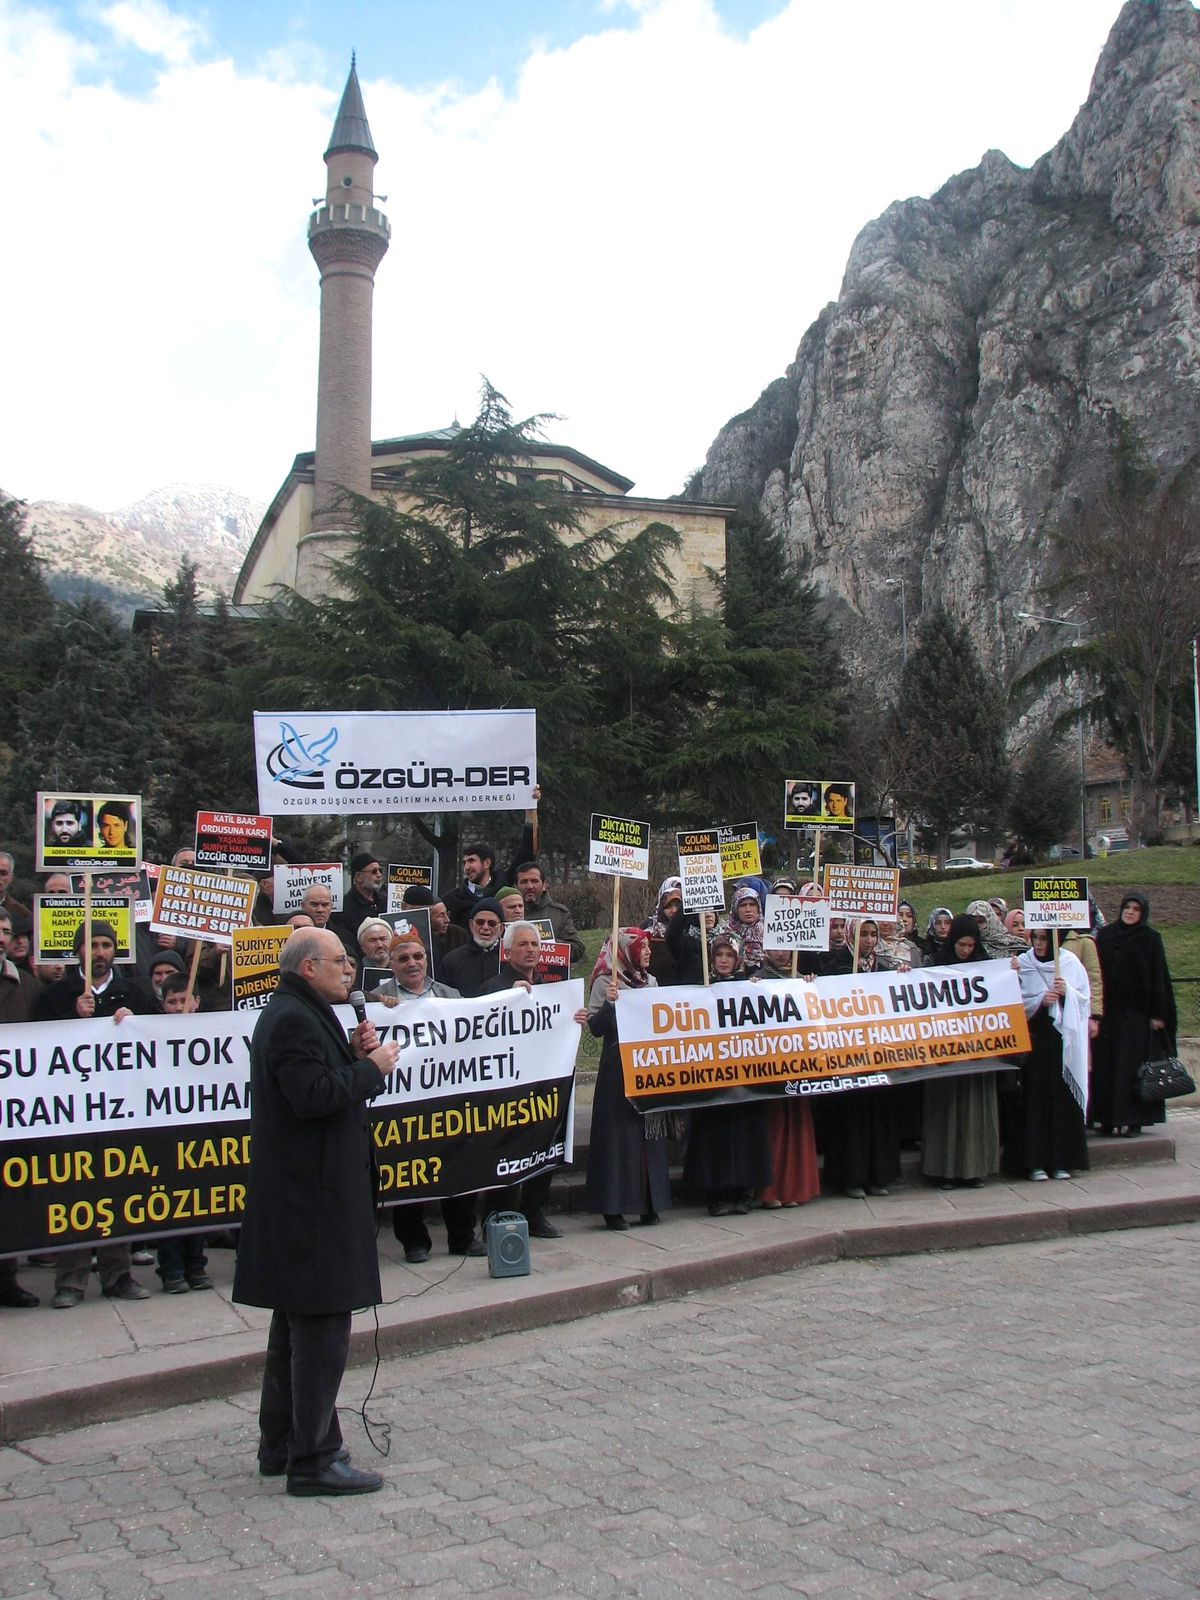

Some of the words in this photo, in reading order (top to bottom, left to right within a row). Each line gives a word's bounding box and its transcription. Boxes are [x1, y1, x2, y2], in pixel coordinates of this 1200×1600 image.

[335, 761, 530, 790] ÖZGÜR-DER
[283, 796, 318, 805] ÖZGÜR
[321, 796, 369, 806] DÜŞÜNCE
[386, 795, 421, 804] EĞİTİM
[425, 795, 469, 804] HAKLARI
[471, 793, 516, 803] DERNEĞİ
[213, 814, 235, 824] KATİL
[237, 817, 257, 826] BAAS
[601, 817, 641, 835] DİKTATÖR
[201, 825, 244, 835] ORDUSUNA
[245, 829, 268, 839] KARŞI
[625, 834, 642, 846] ESAD
[684, 834, 711, 845] GOLAN
[197, 850, 227, 861] ÖZGÜR
[228, 854, 266, 865] ORDUSU!
[604, 845, 634, 858] KATLİAM
[742, 851, 752, 859] DE
[594, 854, 620, 867] ZULÜM
[397, 867, 424, 877] GOLAN
[684, 864, 718, 876] TANKLARI
[829, 866, 850, 877] BAAS
[850, 868, 895, 880] KATLİAMINA
[165, 869, 193, 884] BAAS
[193, 876, 250, 895] KATLİAMINA
[286, 874, 333, 888] SURİYE'DE
[829, 878, 850, 888] GÖZ
[851, 880, 894, 891] YUMMA!
[1033, 878, 1078, 890] DİKTATÖR
[164, 884, 190, 898] GÖZ
[193, 889, 249, 908] YUMMA!
[685, 885, 719, 897] HAMA'DA
[829, 889, 895, 902] KATİLLERDEN
[1060, 890, 1080, 899] ESAD
[45, 898, 80, 907] TÜRKİYELİ
[81, 899, 125, 907] GZETECİLER
[683, 894, 723, 907] HUMUS'TA!
[1039, 902, 1072, 911] KATLİAM
[75, 909, 107, 918] ÖZÖSE
[161, 898, 248, 922] KATİLLERDEN
[866, 902, 894, 913] SOR!
[159, 911, 207, 928] HESAP
[774, 908, 801, 921] STOP
[803, 909, 818, 918] THE
[1029, 911, 1057, 922] ZULÜM
[51, 918, 76, 926] HAMİT
[767, 917, 825, 934] MASSACRE!
[53, 930, 74, 938] ESED
[776, 936, 785, 944] IN
[786, 929, 817, 943] SYRIA
[651, 1001, 711, 1035] Dün
[715, 992, 802, 1029] HAMA
[888, 975, 989, 1014] HUMUS
[0, 1046, 37, 1080] SU
[48, 1039, 158, 1083] AÇKEN
[166, 1035, 234, 1068] TOK
[454, 1001, 561, 1044] DEĞİLDİR"
[631, 1040, 715, 1069] KATLİAM
[718, 1028, 805, 1061] SÜRÜYOR
[808, 1024, 866, 1052] SURİYE
[867, 1022, 918, 1045] HALKI
[918, 1011, 1012, 1041] DİRENİYOR
[634, 1073, 677, 1091] BAAS
[679, 1064, 740, 1086] DİKTASI
[741, 1057, 824, 1080] YIKILACAK,
[825, 1050, 871, 1071] İSLAMİ
[874, 1045, 926, 1064] DİRENİŞ
[929, 1034, 1018, 1059] KAZANACAK!
[0, 1093, 75, 1129] RAN
[85, 1090, 135, 1122] Hz.
[419, 1045, 521, 1091] ÜMMETİ,
[801, 1073, 890, 1095] ÖZGÜR-DER
[2, 1149, 96, 1189] OLUR
[103, 1144, 160, 1179] DA,
[371, 1087, 559, 1148] KATLEDİLMESİNİ
[496, 1142, 564, 1177] ÖZGÜR-DE
[47, 1197, 116, 1238] BOŞ
[122, 1183, 248, 1225] GÖZLER
